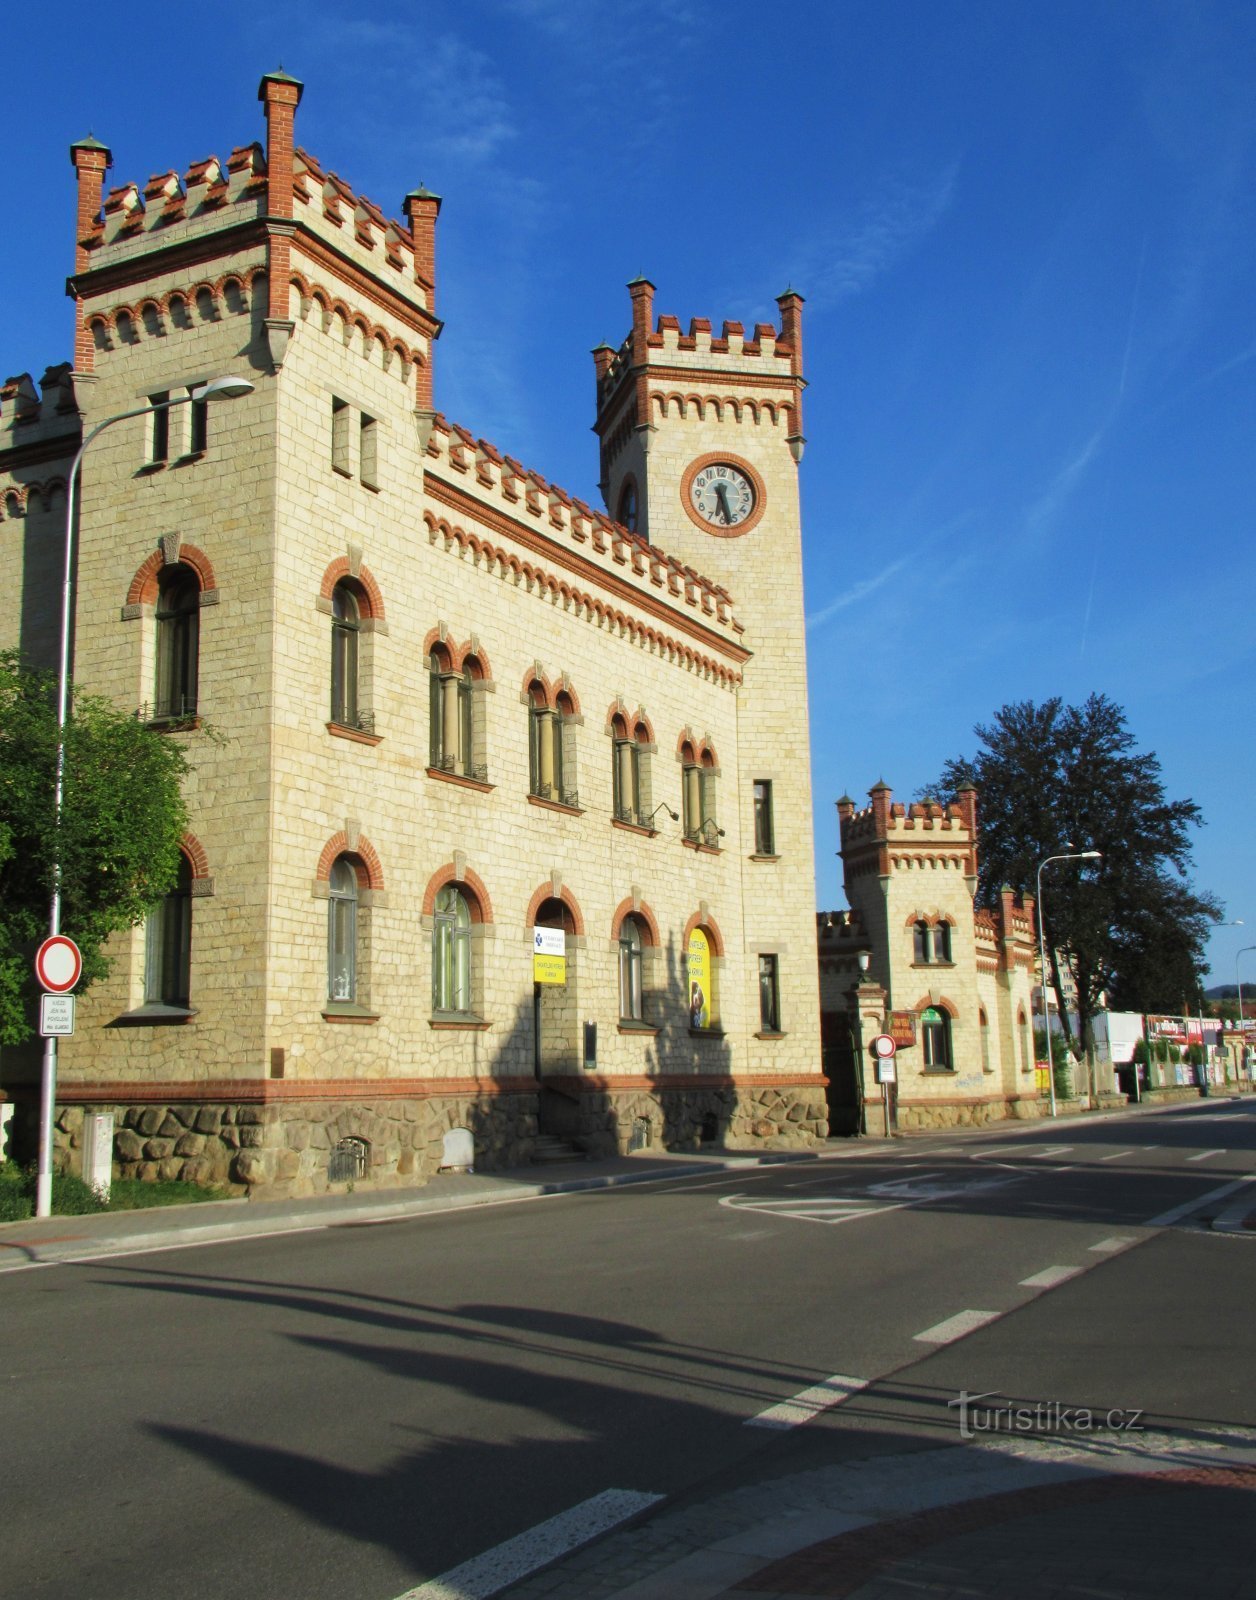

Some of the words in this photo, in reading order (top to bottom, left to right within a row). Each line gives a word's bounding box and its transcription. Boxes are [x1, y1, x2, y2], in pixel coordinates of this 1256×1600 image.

[706, 470, 713, 479] 11
[717, 467, 726, 478] 12
[697, 477, 705, 487] 10
[740, 481, 747, 490] 2
[694, 489, 702, 498] 9
[743, 492, 750, 502] 3
[698, 502, 705, 511] 8
[739, 505, 747, 514] 4
[707, 511, 714, 520] 7
[731, 513, 738, 523] 5
